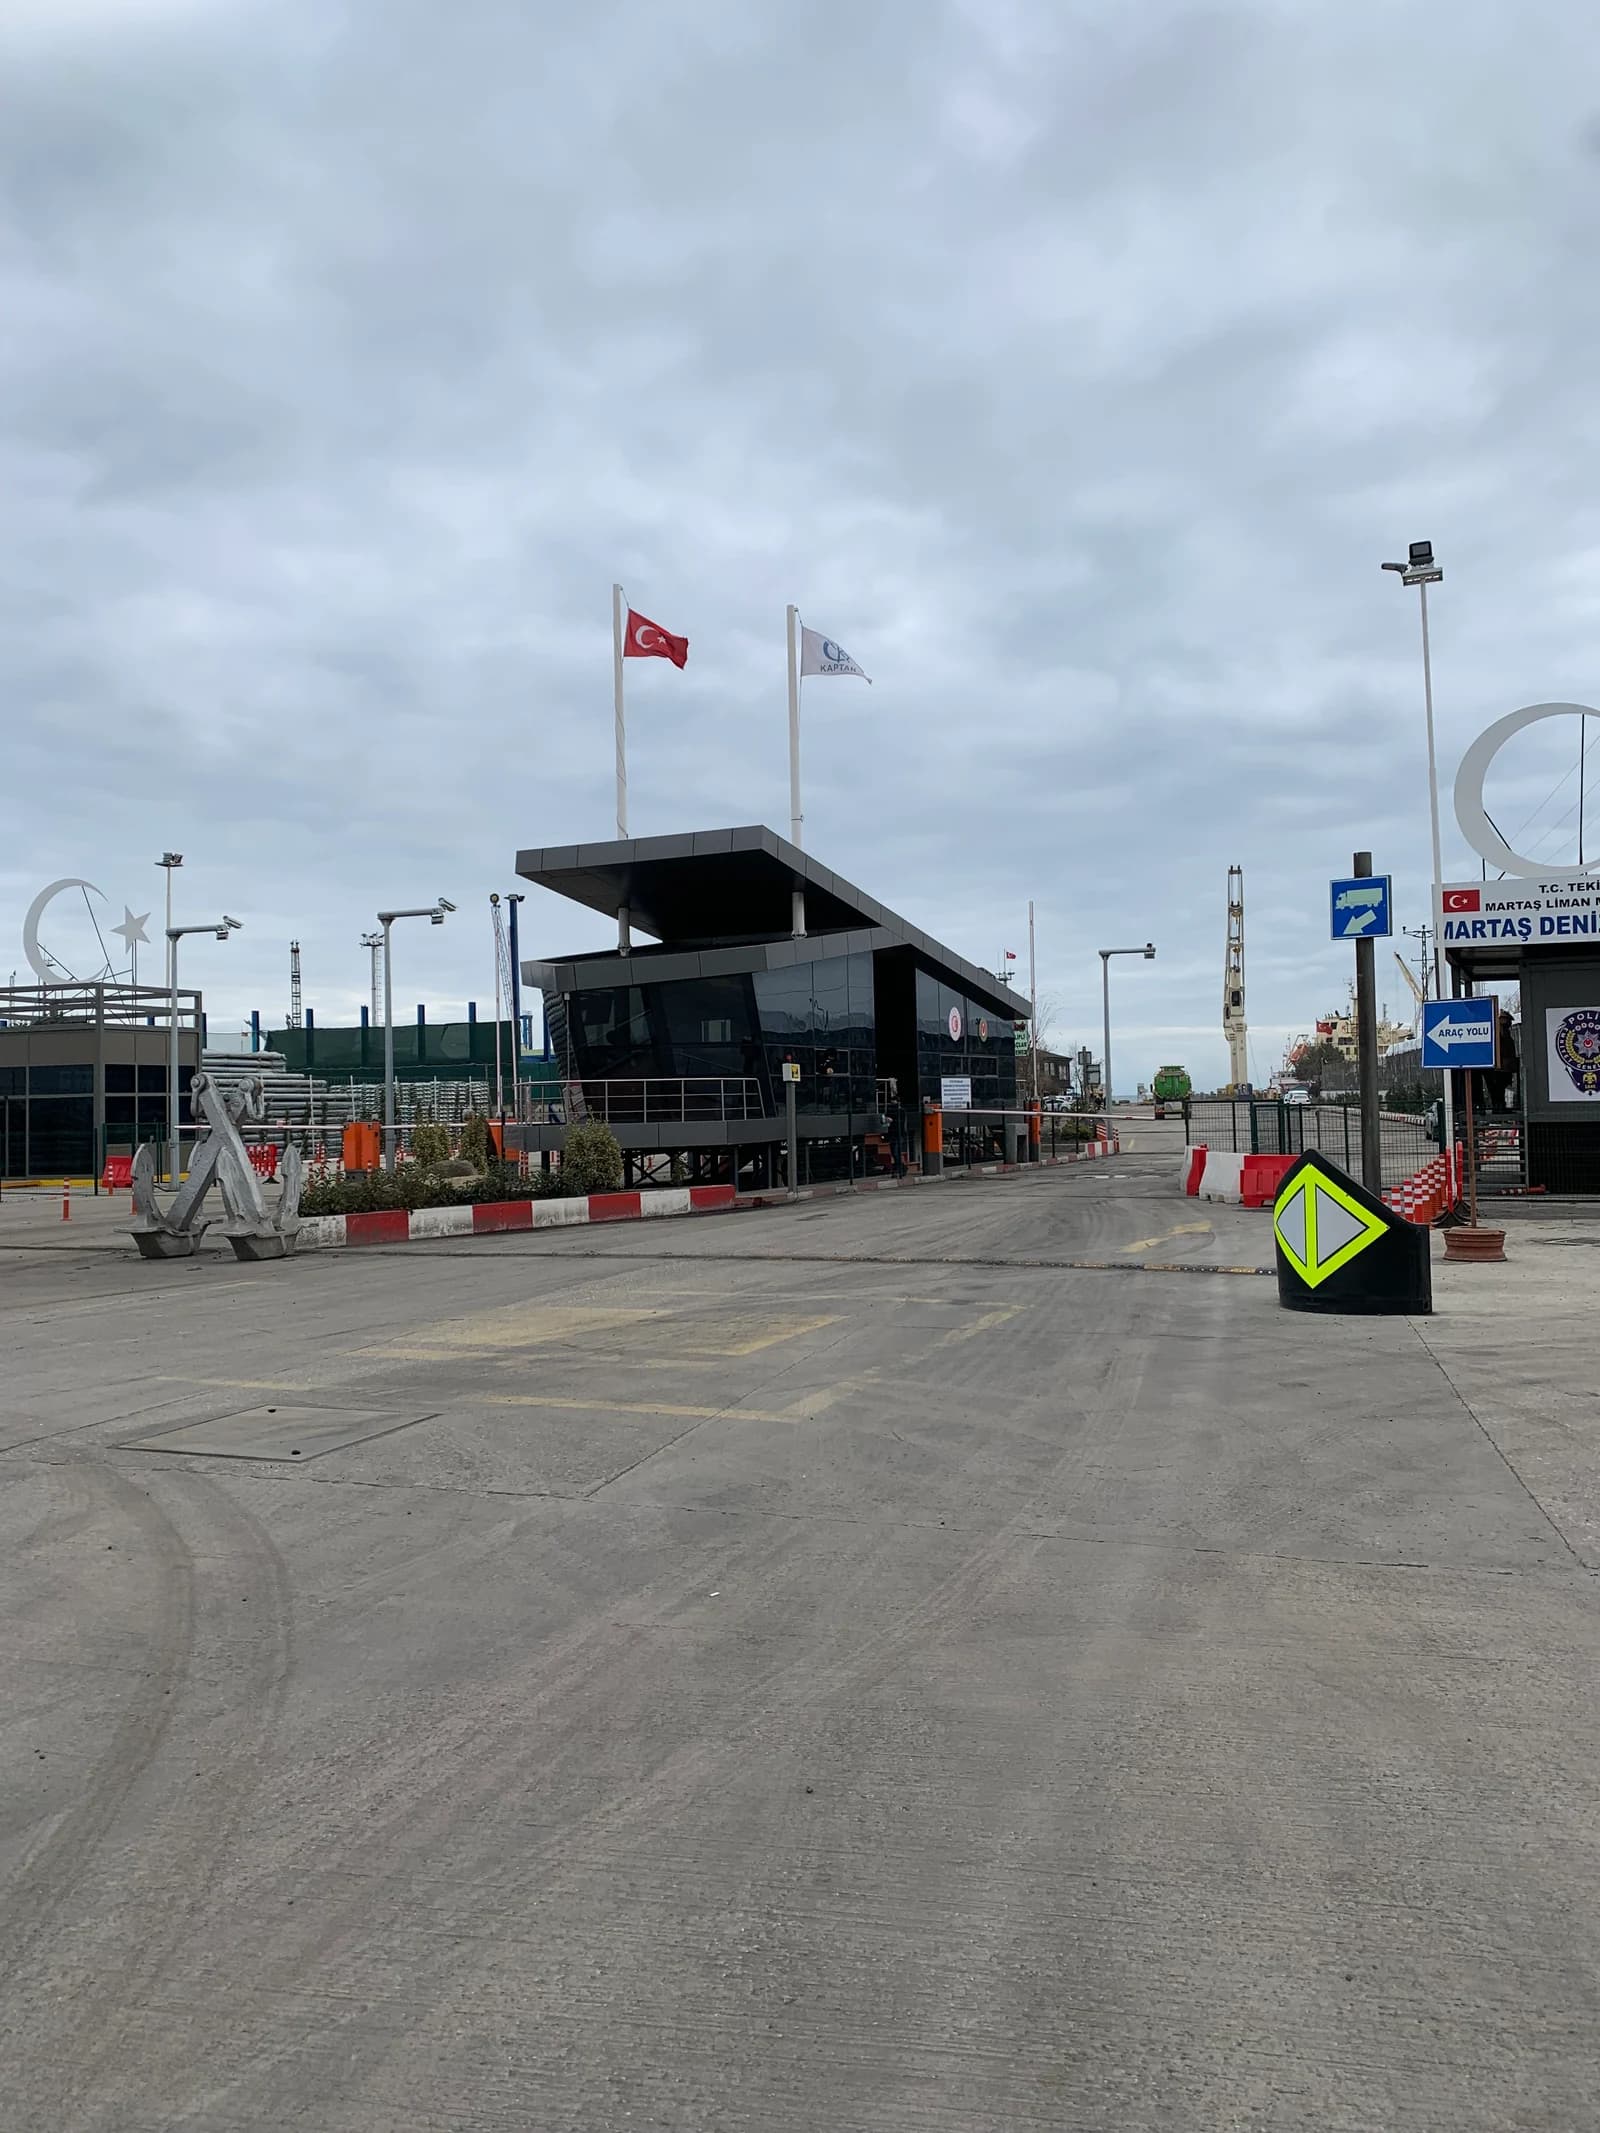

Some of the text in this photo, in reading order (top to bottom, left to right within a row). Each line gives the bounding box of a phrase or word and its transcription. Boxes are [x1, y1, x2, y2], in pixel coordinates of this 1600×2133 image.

[1538, 884, 1563, 893] T.C.
[1485, 900, 1541, 912] MARTAŞ
[1546, 897, 1590, 908] LİMAN
[1540, 910, 1600, 936] DENİ
[1438, 1027, 1489, 1039] ARAÇ YOLU
